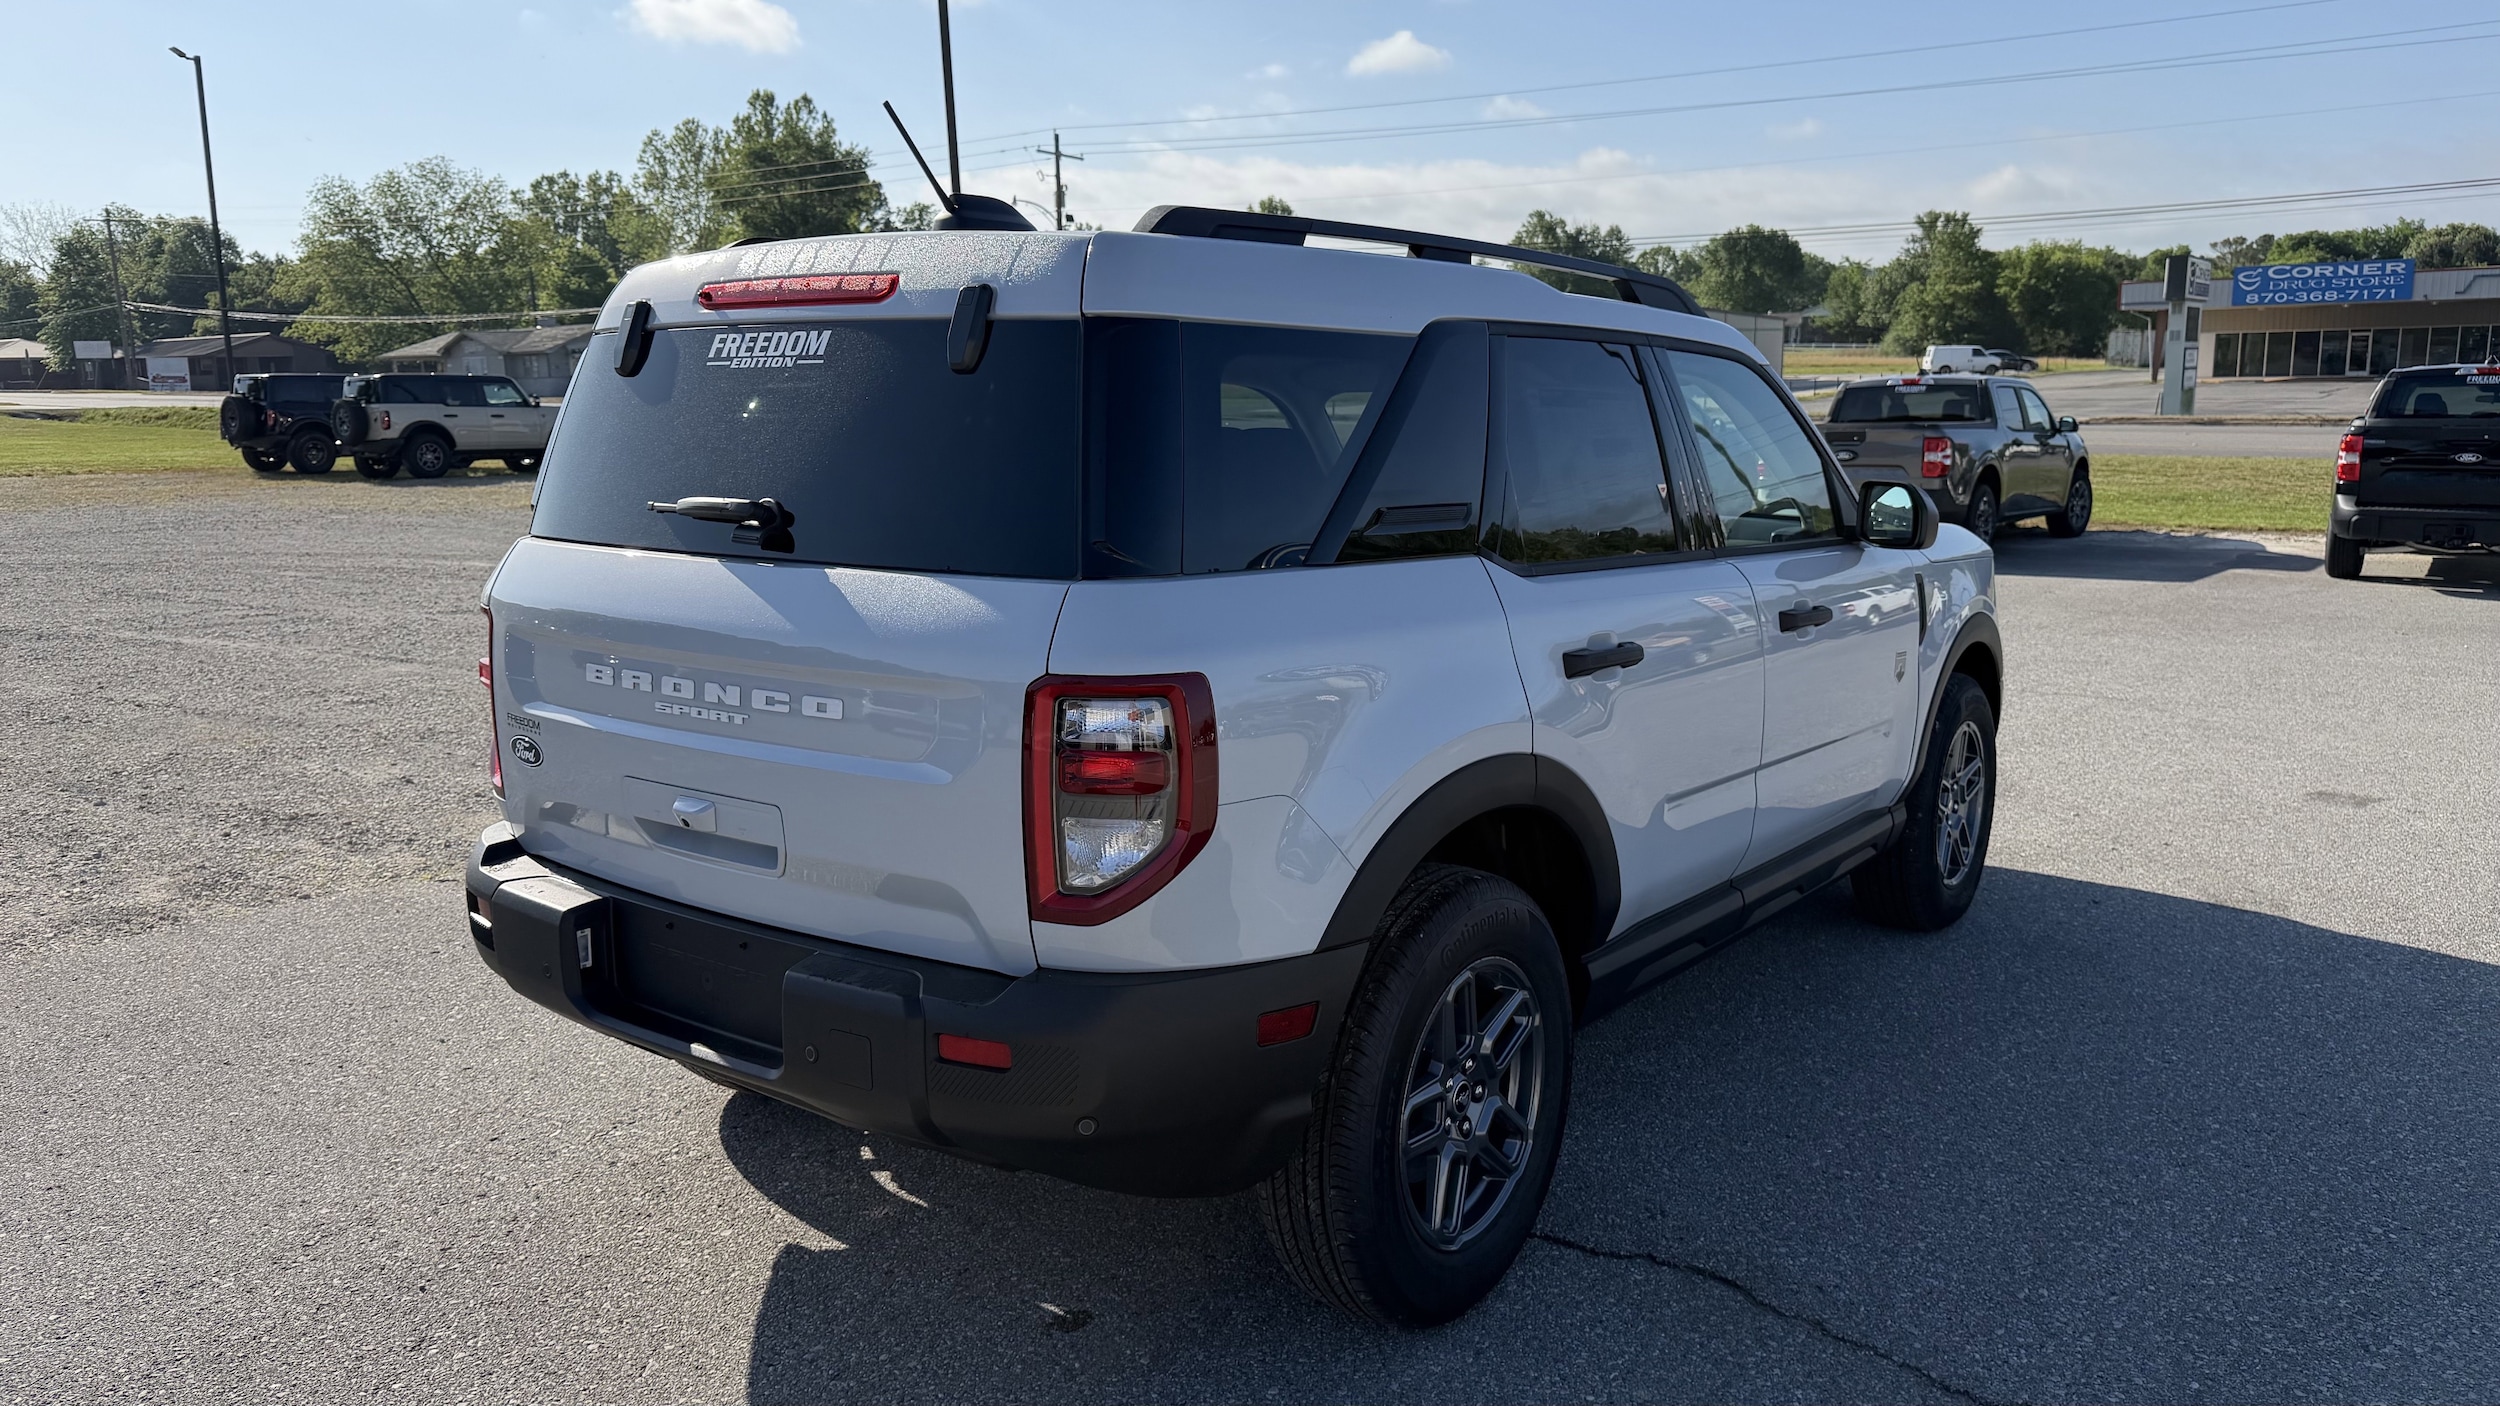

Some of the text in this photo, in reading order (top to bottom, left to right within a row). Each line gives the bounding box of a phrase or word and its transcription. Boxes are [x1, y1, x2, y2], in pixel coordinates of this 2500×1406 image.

[2267, 262, 2407, 279] CORNER
[2269, 275, 2405, 291] DRUG STORE
[2245, 288, 2396, 304] 870-368-7171
[708, 330, 832, 358] FREEDOM
[730, 357, 796, 369] EDITION
[586, 663, 844, 720] BRONCO
[507, 712, 541, 731] FREEDOM
[654, 701, 749, 725] SPORT
[1441, 906, 1510, 968] Continental
